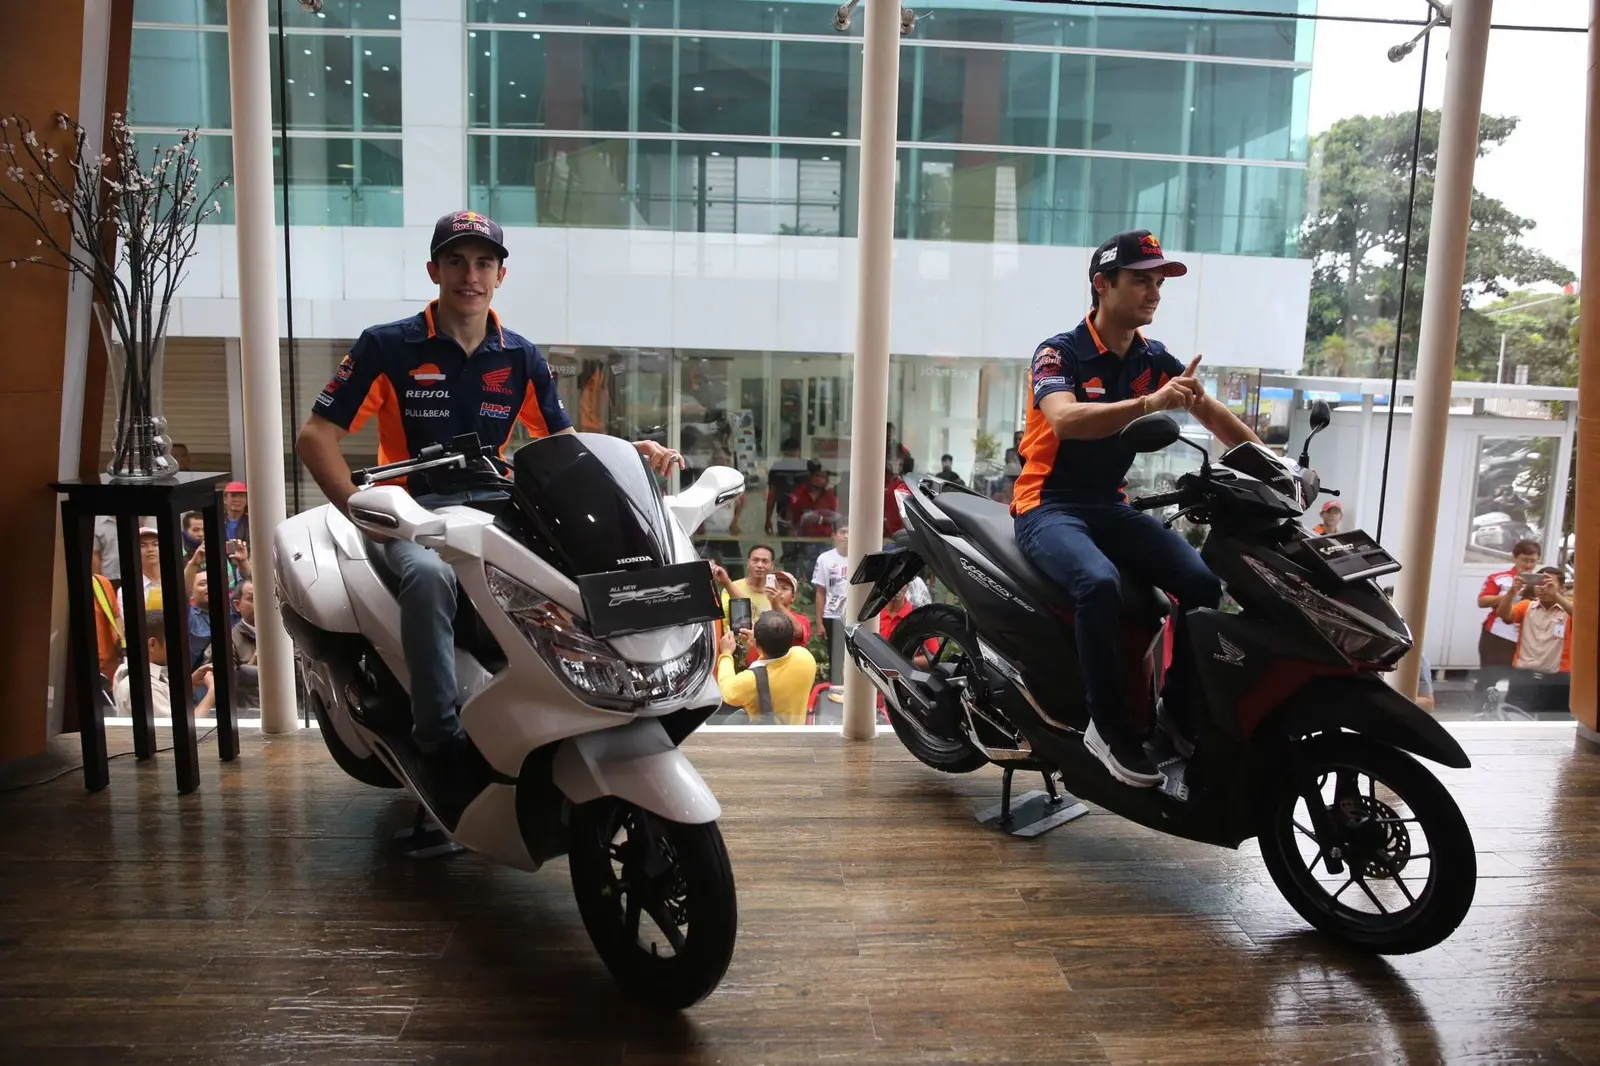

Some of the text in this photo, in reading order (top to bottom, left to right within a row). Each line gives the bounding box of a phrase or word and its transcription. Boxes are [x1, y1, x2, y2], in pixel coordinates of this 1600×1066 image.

[453, 221, 491, 236] Red Bull
[1100, 246, 1118, 265] 26
[405, 390, 450, 398] REPSOL
[481, 385, 513, 395] HONDA
[405, 408, 450, 417] PULL&BEAR
[480, 402, 511, 419] HRC
[616, 555, 653, 565] HONDA
[1012, 596, 1036, 612] 150
